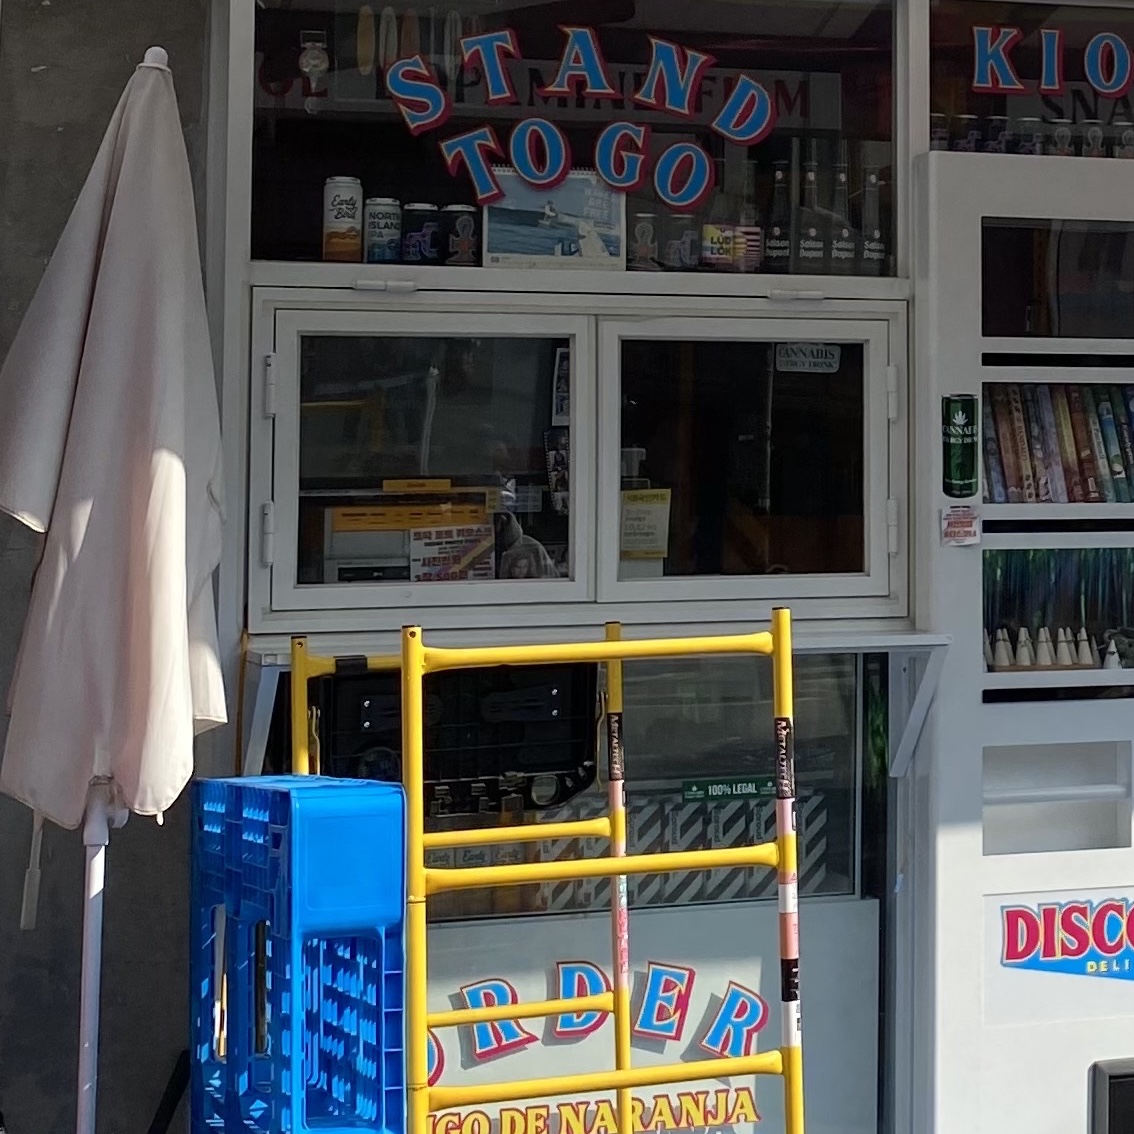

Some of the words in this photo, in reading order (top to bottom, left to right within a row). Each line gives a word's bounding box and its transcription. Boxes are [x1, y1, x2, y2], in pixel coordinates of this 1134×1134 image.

[386, 22, 777, 146] STAND
[440, 116, 572, 205] TO
[595, 121, 717, 211] GO
[331, 194, 358, 211] Early
[610, 715, 625, 778] METALTECH
[778, 720, 794, 794] METALTECH
[707, 784, 732, 796] 100%
[732, 782, 758, 795] LEGAL
